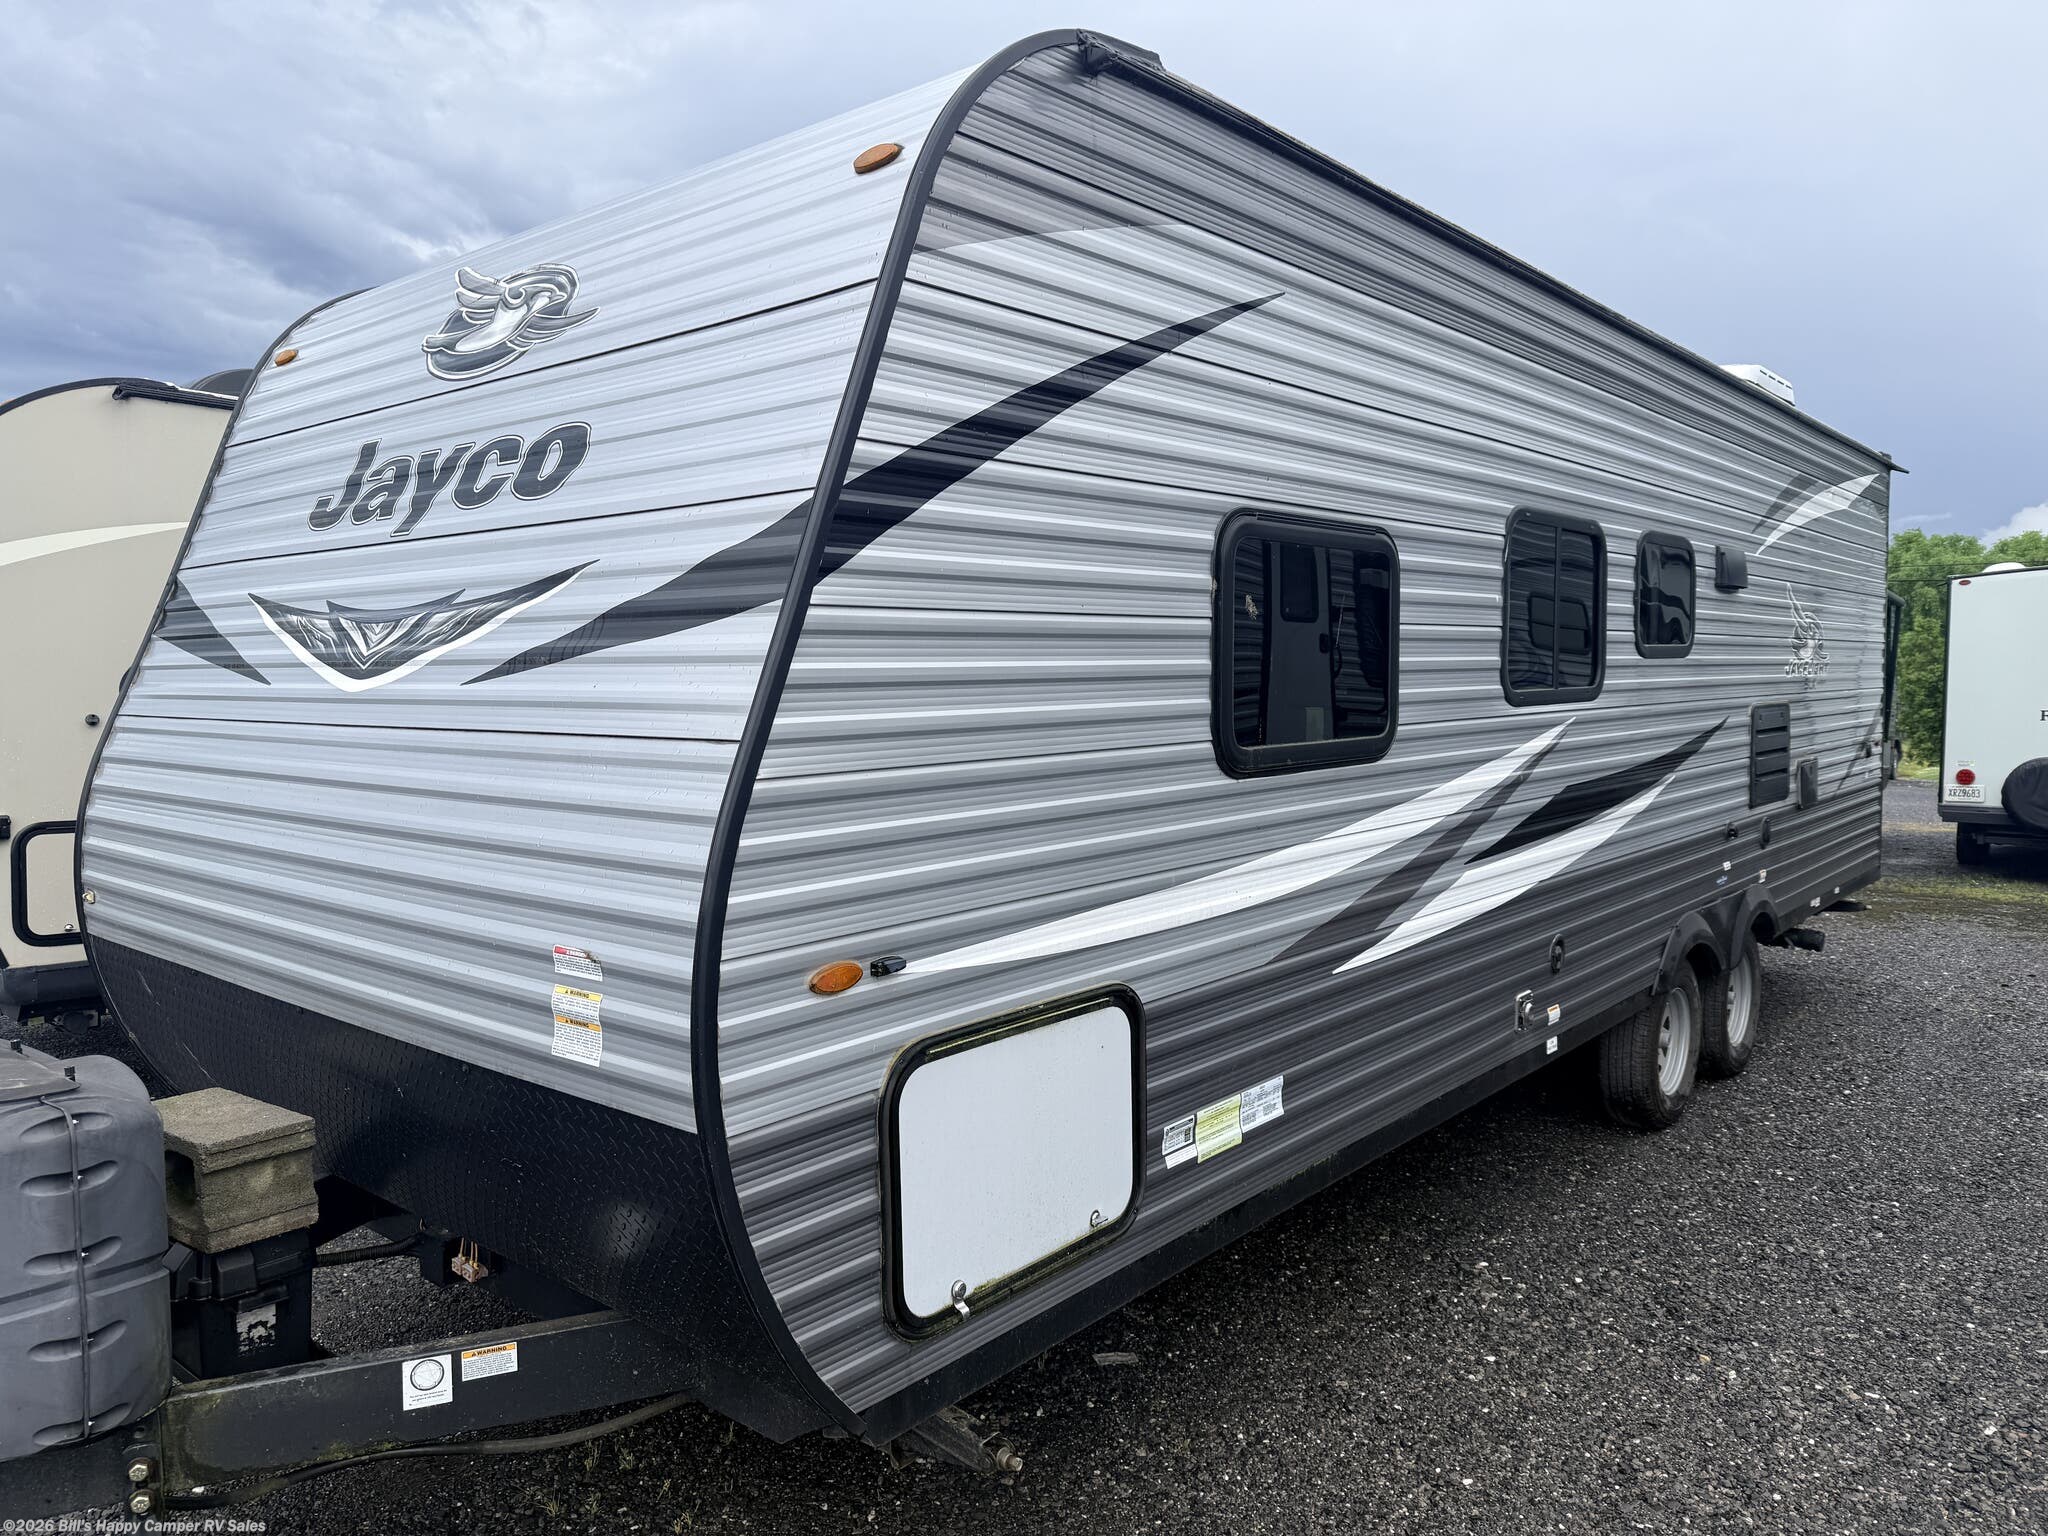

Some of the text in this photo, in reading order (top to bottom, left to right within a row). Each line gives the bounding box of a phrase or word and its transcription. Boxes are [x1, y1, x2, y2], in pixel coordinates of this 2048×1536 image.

[307, 421, 592, 537] Jayco
[1948, 788, 1981, 799] XRZ9683
[569, 988, 590, 999] WARNING
[569, 1019, 590, 1029] WARNING
[477, 1345, 507, 1356] WARNING
